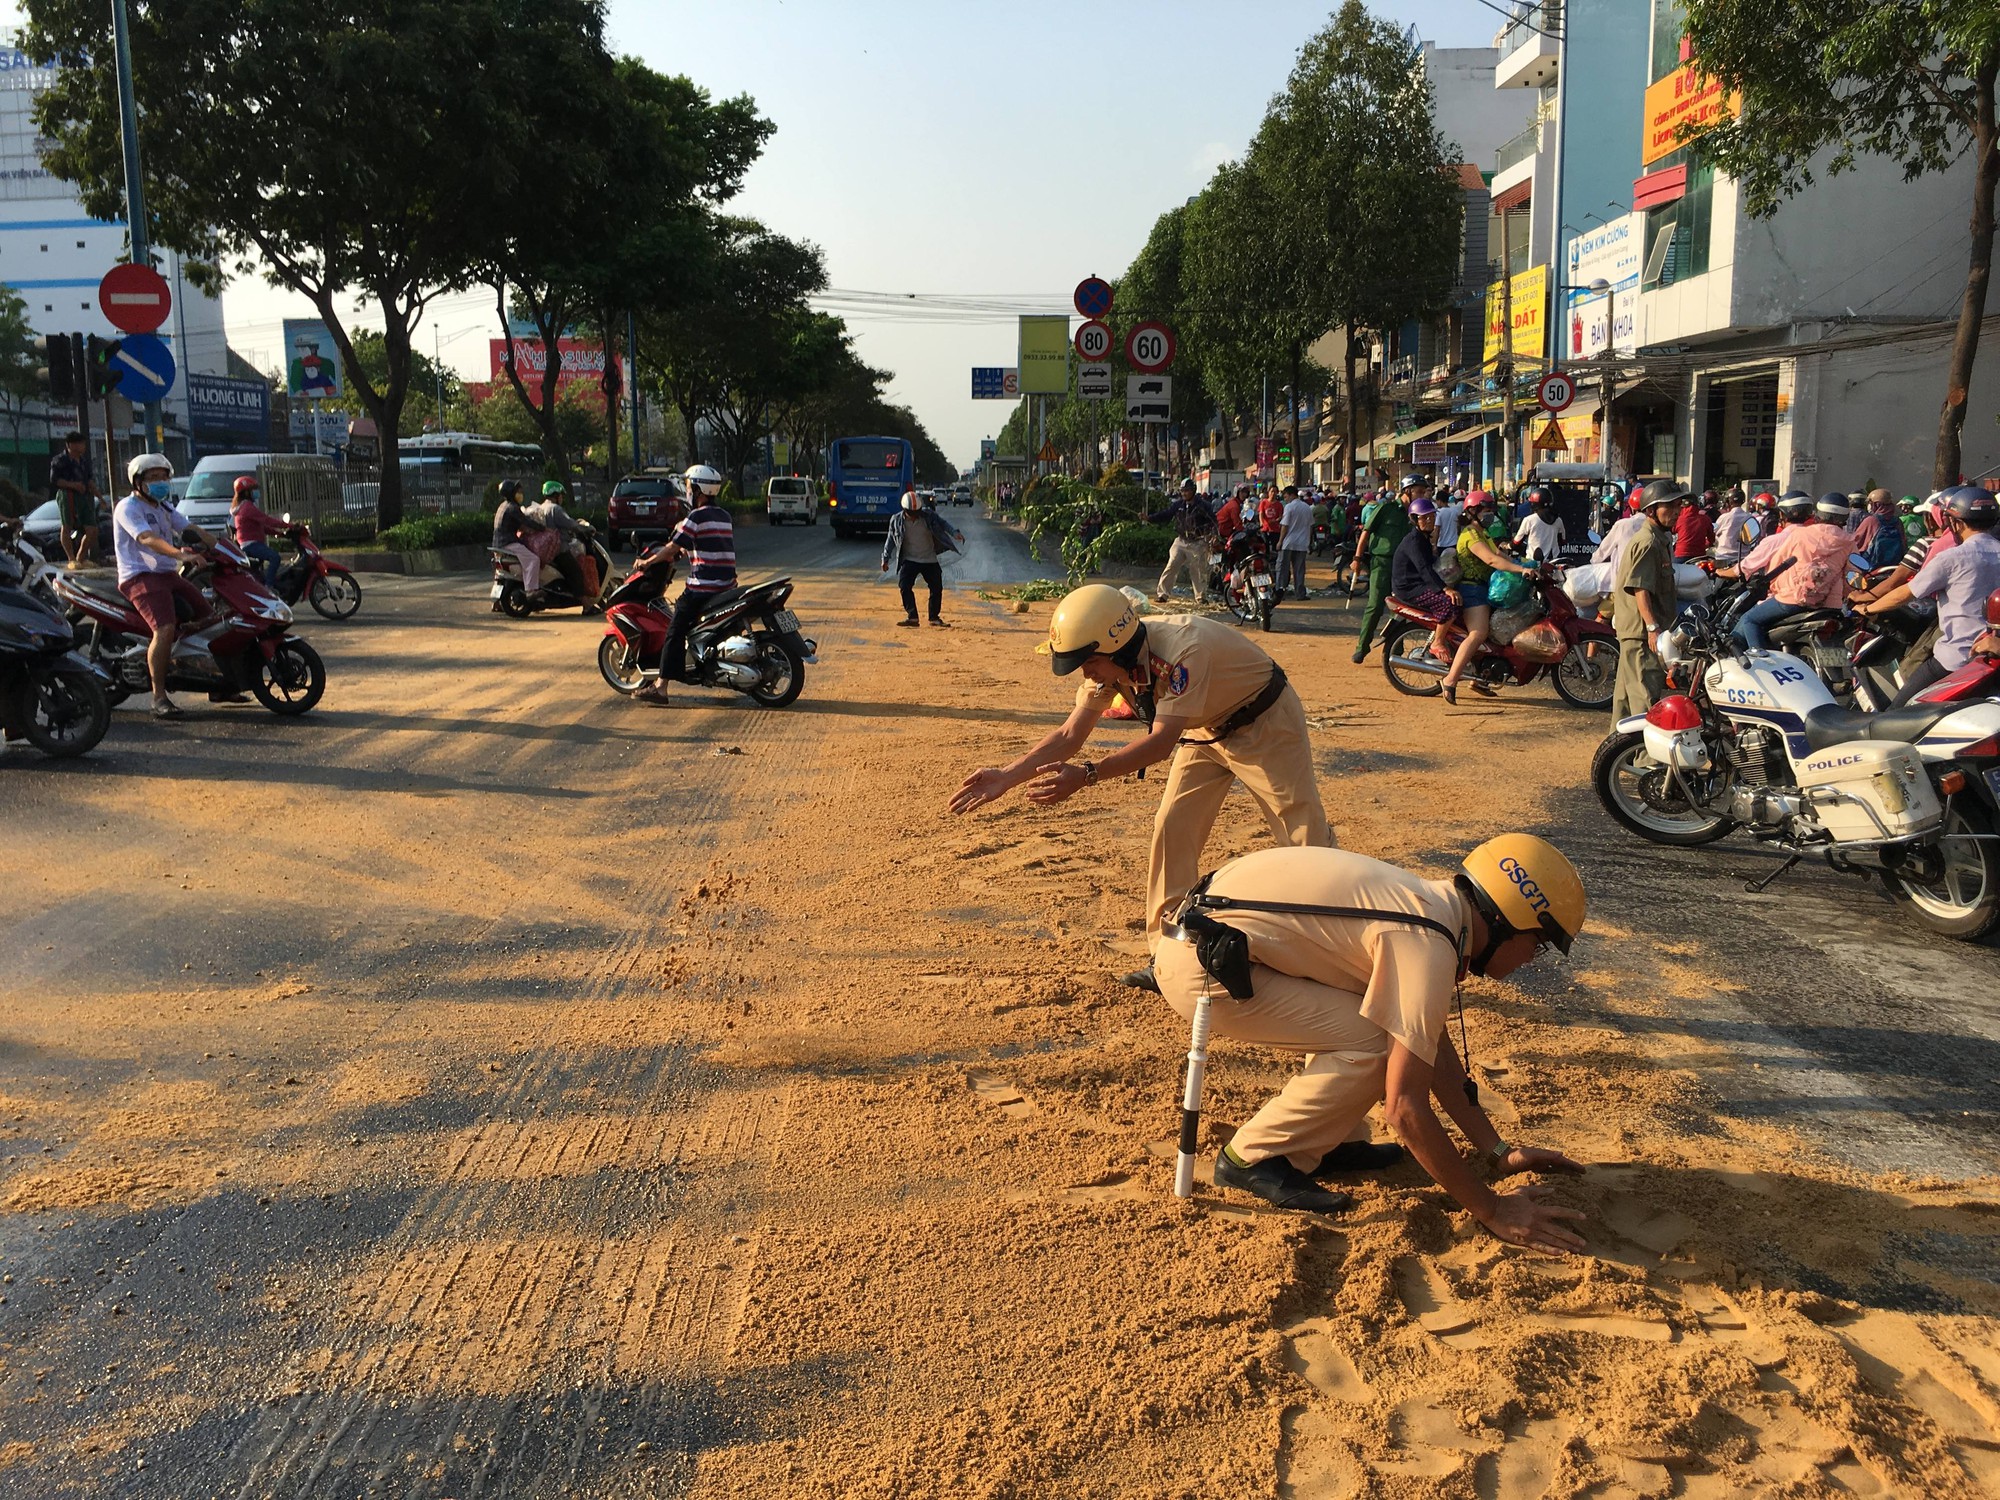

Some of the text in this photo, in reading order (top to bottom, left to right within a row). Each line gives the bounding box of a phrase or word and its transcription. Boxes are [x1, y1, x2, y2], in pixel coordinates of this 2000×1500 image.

[1595, 236, 1605, 253] KIM
[1515, 305, 1537, 329] ĐẤT
[1613, 313, 1633, 341] KHOA
[1084, 332, 1103, 351] 80
[1137, 335, 1162, 360] 60
[237, 391, 262, 408] LINH
[1548, 384, 1564, 401] 50
[1108, 607, 1136, 639] CSGT
[1771, 666, 1805, 686] A5
[1807, 753, 1864, 772] POLICE
[1499, 857, 1551, 912] CSGT
